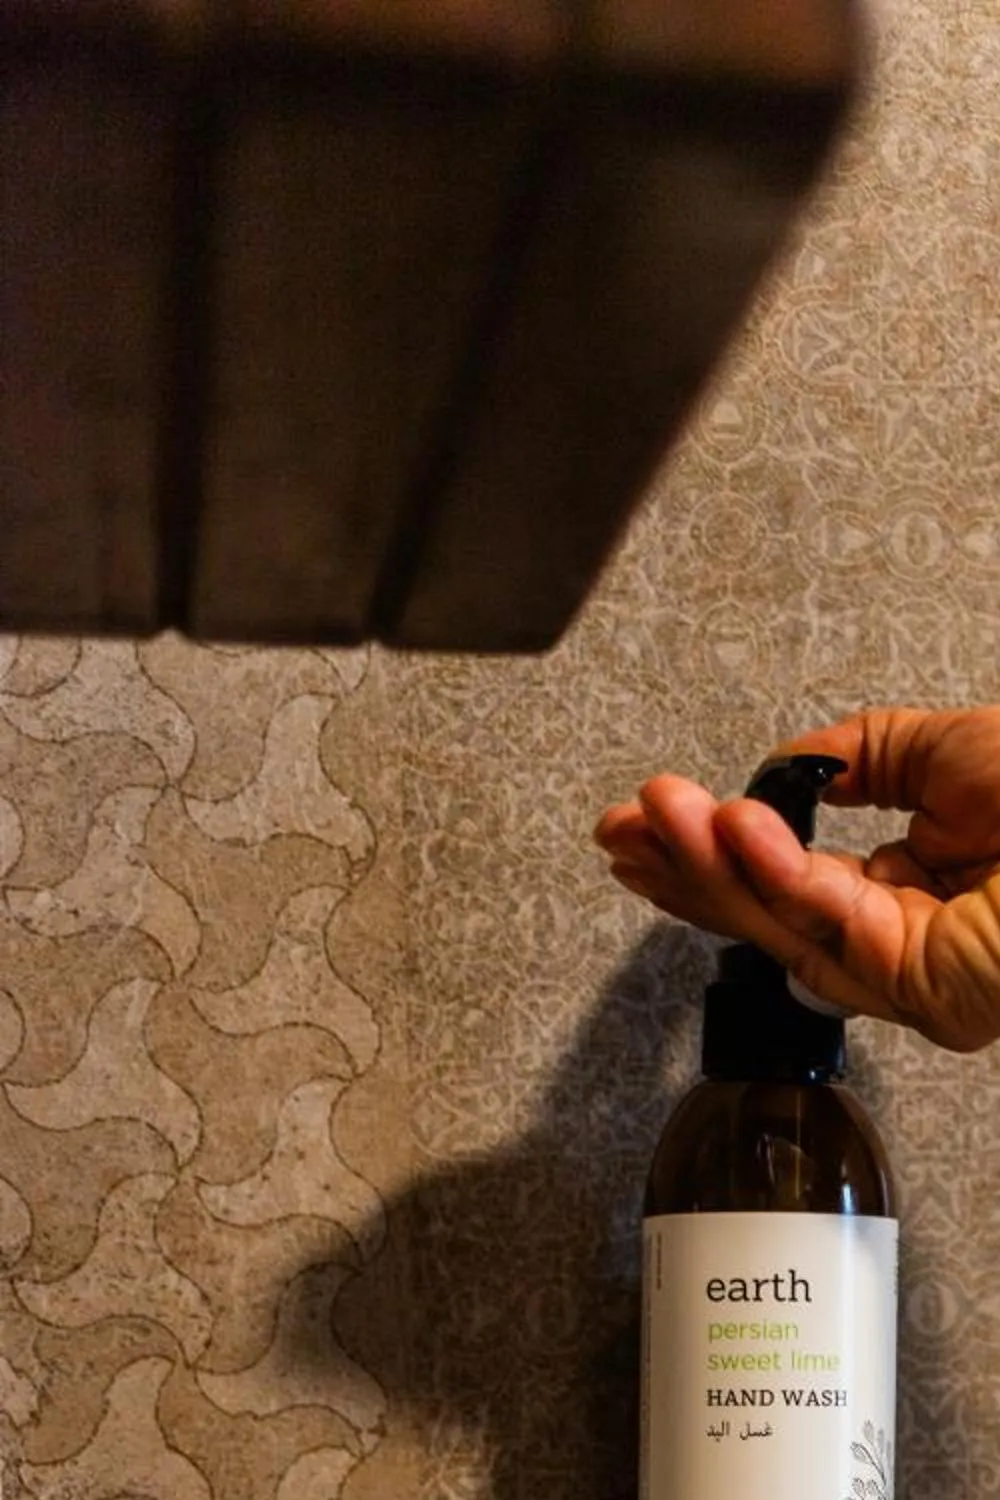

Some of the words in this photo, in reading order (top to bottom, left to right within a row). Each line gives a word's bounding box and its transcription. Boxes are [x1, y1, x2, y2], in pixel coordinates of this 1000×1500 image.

[706, 1269, 812, 1303] earth
[708, 1319, 799, 1343] persian
[707, 1352, 782, 1371] sweet
[791, 1350, 840, 1371] lime
[706, 1389, 774, 1407] HAND
[782, 1389, 848, 1407] WASH
